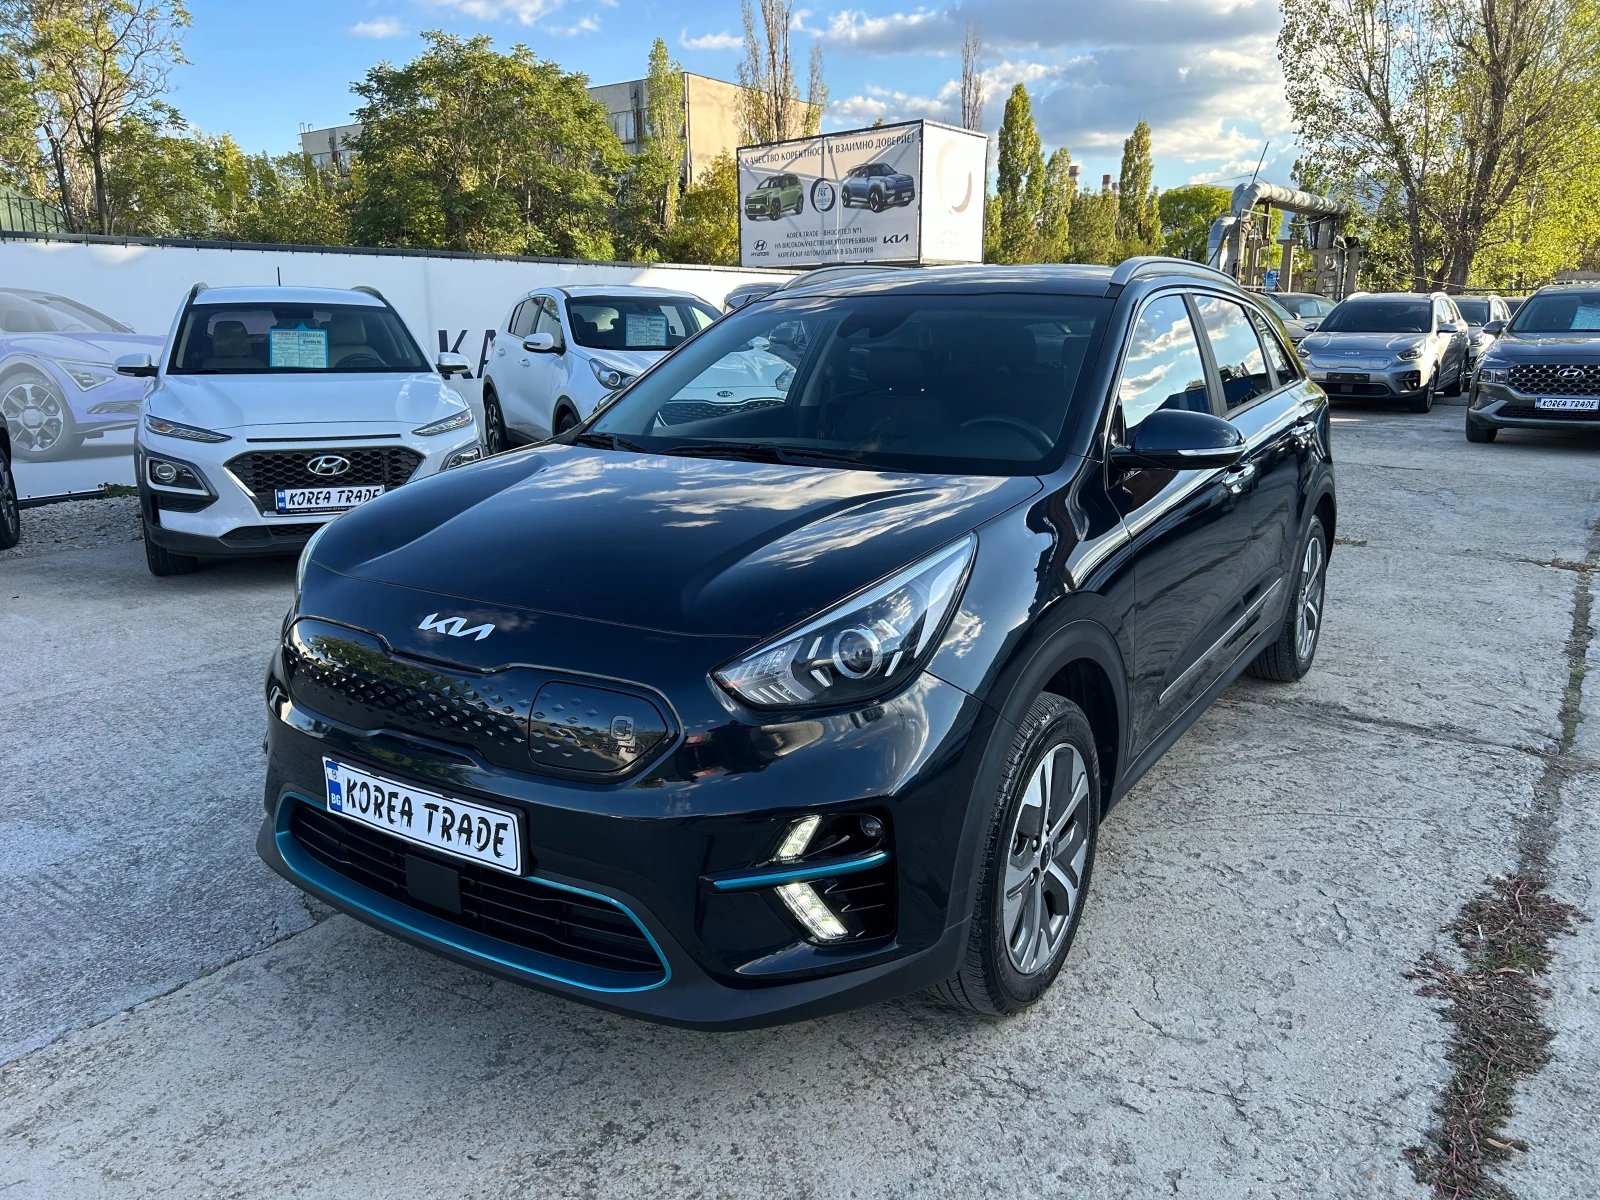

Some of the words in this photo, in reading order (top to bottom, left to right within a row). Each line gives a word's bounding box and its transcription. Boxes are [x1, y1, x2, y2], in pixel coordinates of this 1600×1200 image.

[744, 153, 780, 165] КАЧЕСТВО
[781, 146, 825, 161] КОРЕКТНОСТ
[827, 145, 833, 155] И
[835, 139, 874, 154] ВЗАИМНО
[875, 133, 915, 150] ДОВЕРИЕ!
[786, 231, 802, 239] KOREA
[803, 229, 819, 238] TRADE
[823, 228, 851, 236] ВНОСИТЕЛ
[883, 233, 909, 244] KIA
[777, 250, 803, 259] КОРЕЙСКИ
[845, 246, 874, 255] БЪЛГАРИЯ
[1541, 400, 1567, 408] KOREA
[1570, 400, 1596, 408] TRADE
[288, 490, 332, 506] KOREA
[418, 612, 496, 641] KIA
[331, 792, 341, 804] BG
[346, 776, 414, 831] KOREA
[422, 802, 509, 859] TRADE
